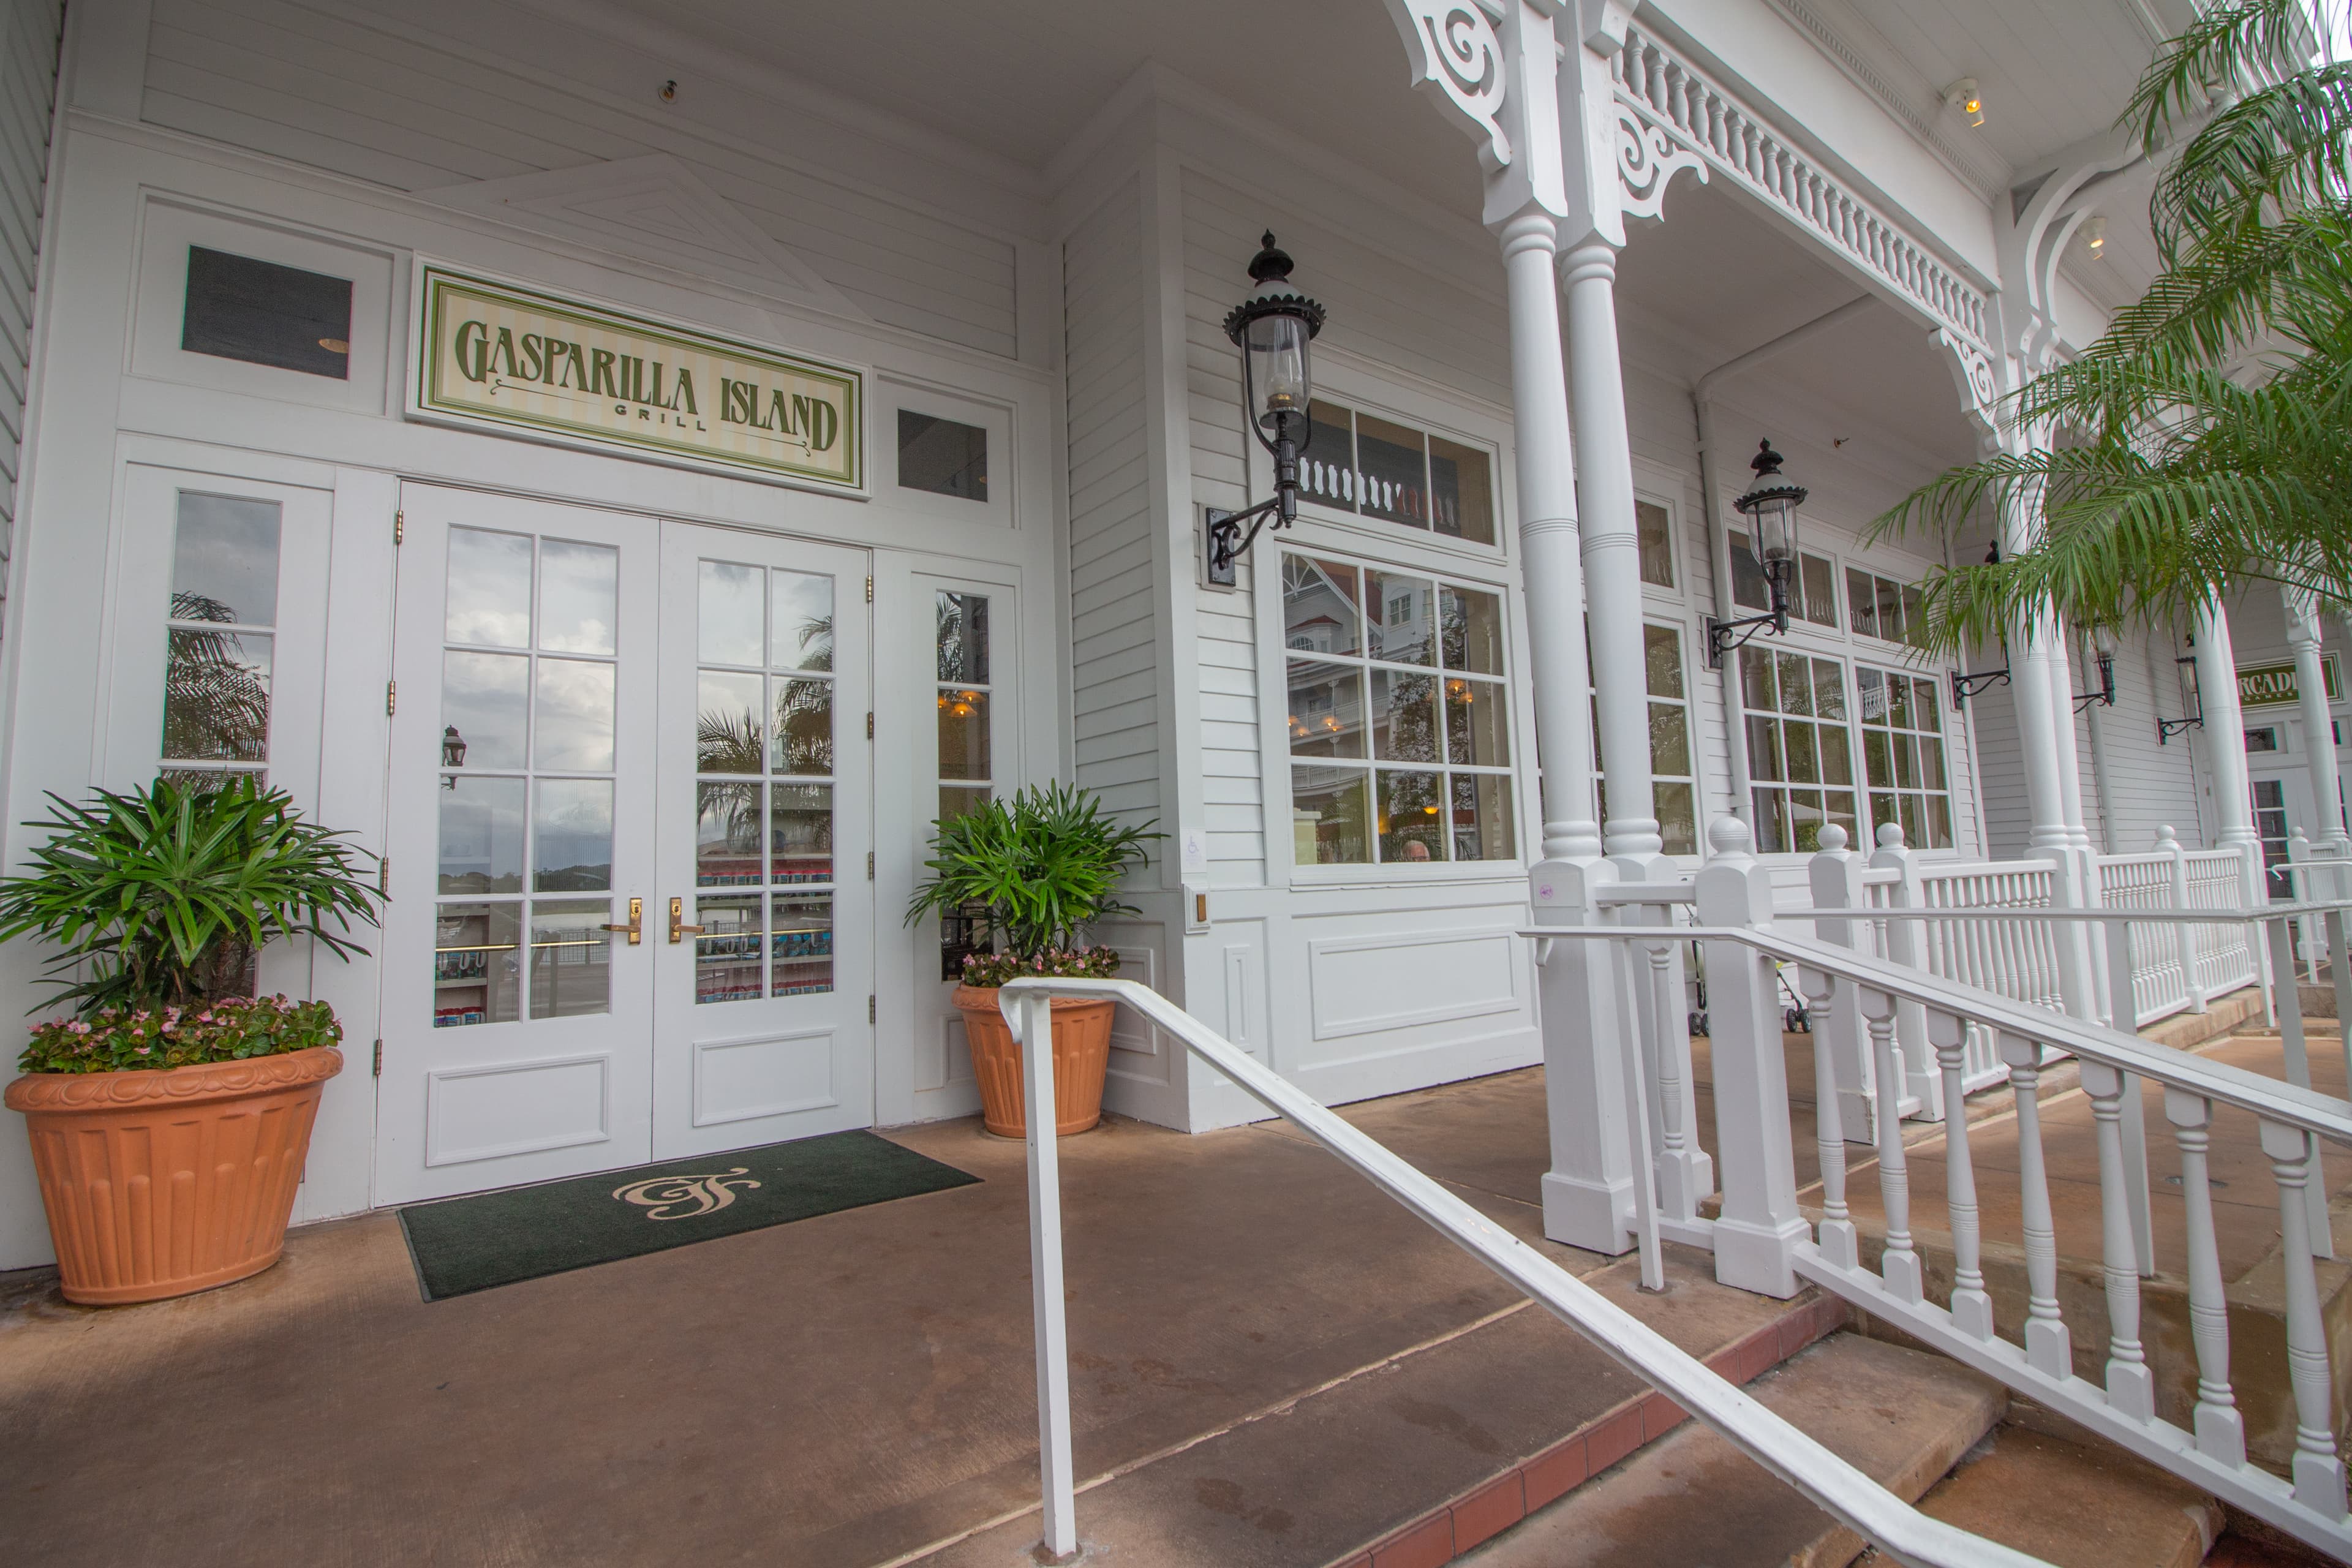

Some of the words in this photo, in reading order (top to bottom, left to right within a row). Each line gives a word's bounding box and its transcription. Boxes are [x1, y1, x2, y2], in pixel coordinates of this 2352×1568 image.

[455, 320, 699, 415] GASPARILLA
[720, 377, 838, 452] ISLAND
[615, 404, 707, 432] GRILL
[2237, 671, 2298, 696] RCAD
[2244, 692, 2293, 701] GAMES
